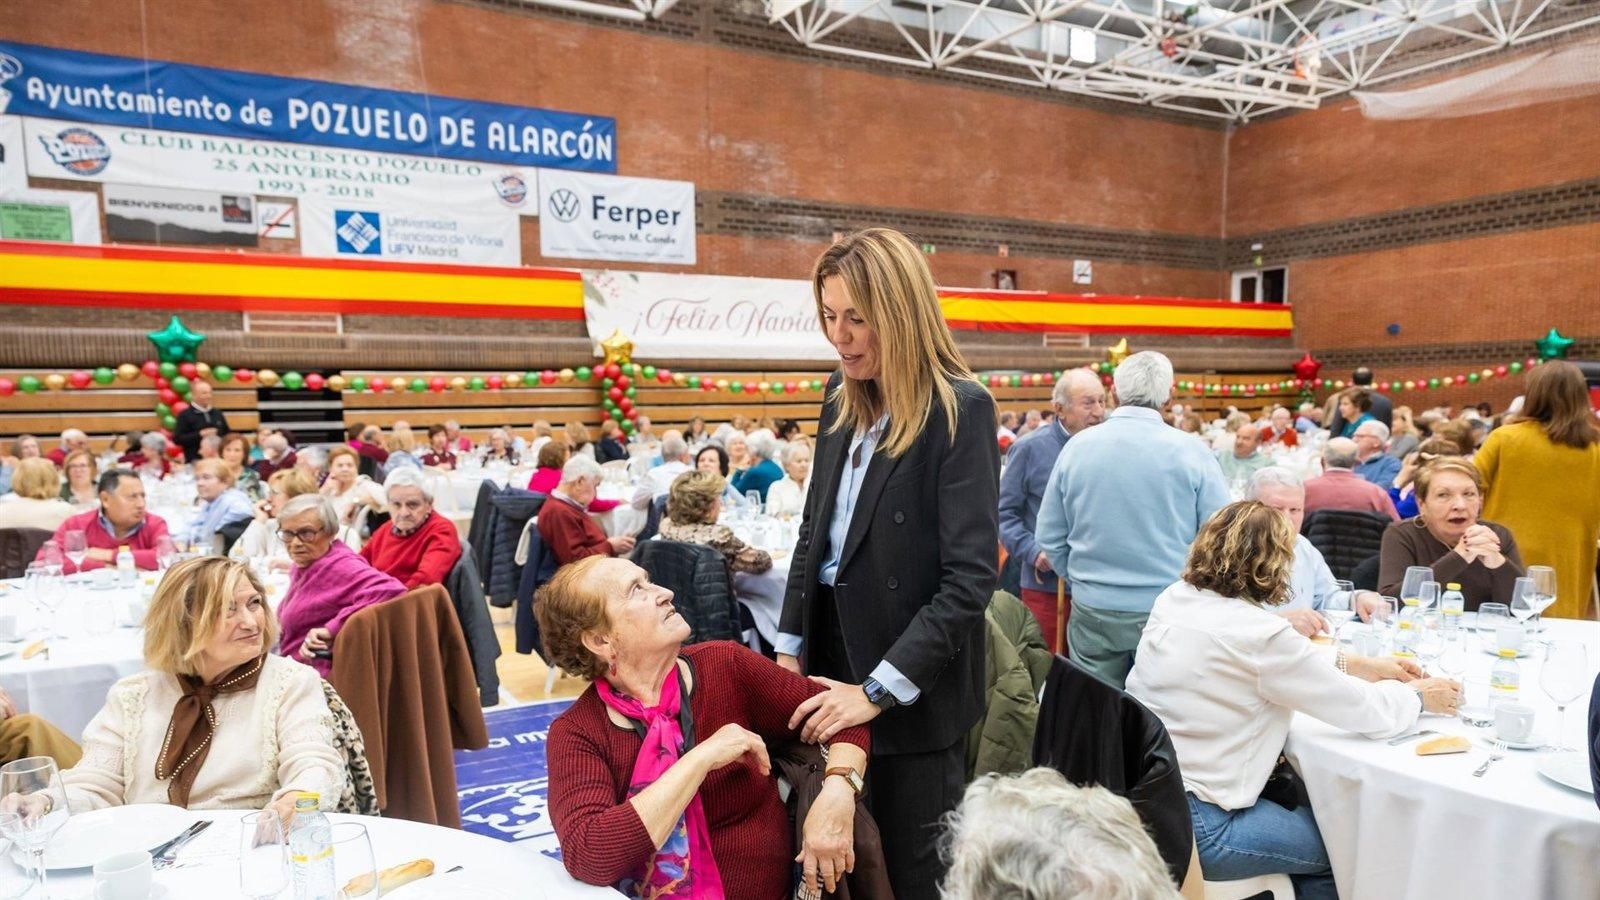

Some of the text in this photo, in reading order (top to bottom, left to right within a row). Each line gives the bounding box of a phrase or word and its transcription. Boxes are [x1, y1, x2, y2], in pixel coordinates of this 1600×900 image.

[27, 77, 613, 162] Ayuntamiento de POZUELO DE ALARCÓN
[120, 131, 482, 176] CLUB BALONCESTO POZUELO
[214, 159, 410, 185] 25 ANIVERSARIO
[258, 179, 306, 193] 1993
[328, 185, 374, 198] 2018
[108, 198, 205, 212] BIENVENIDOS
[592, 195, 681, 229] Ferper
[386, 216, 457, 231] Universidad
[387, 229, 448, 243] Francisco
[450, 233, 465, 245] de
[388, 243, 459, 257] UFV Madrid
[726, 299, 820, 337] Navid
